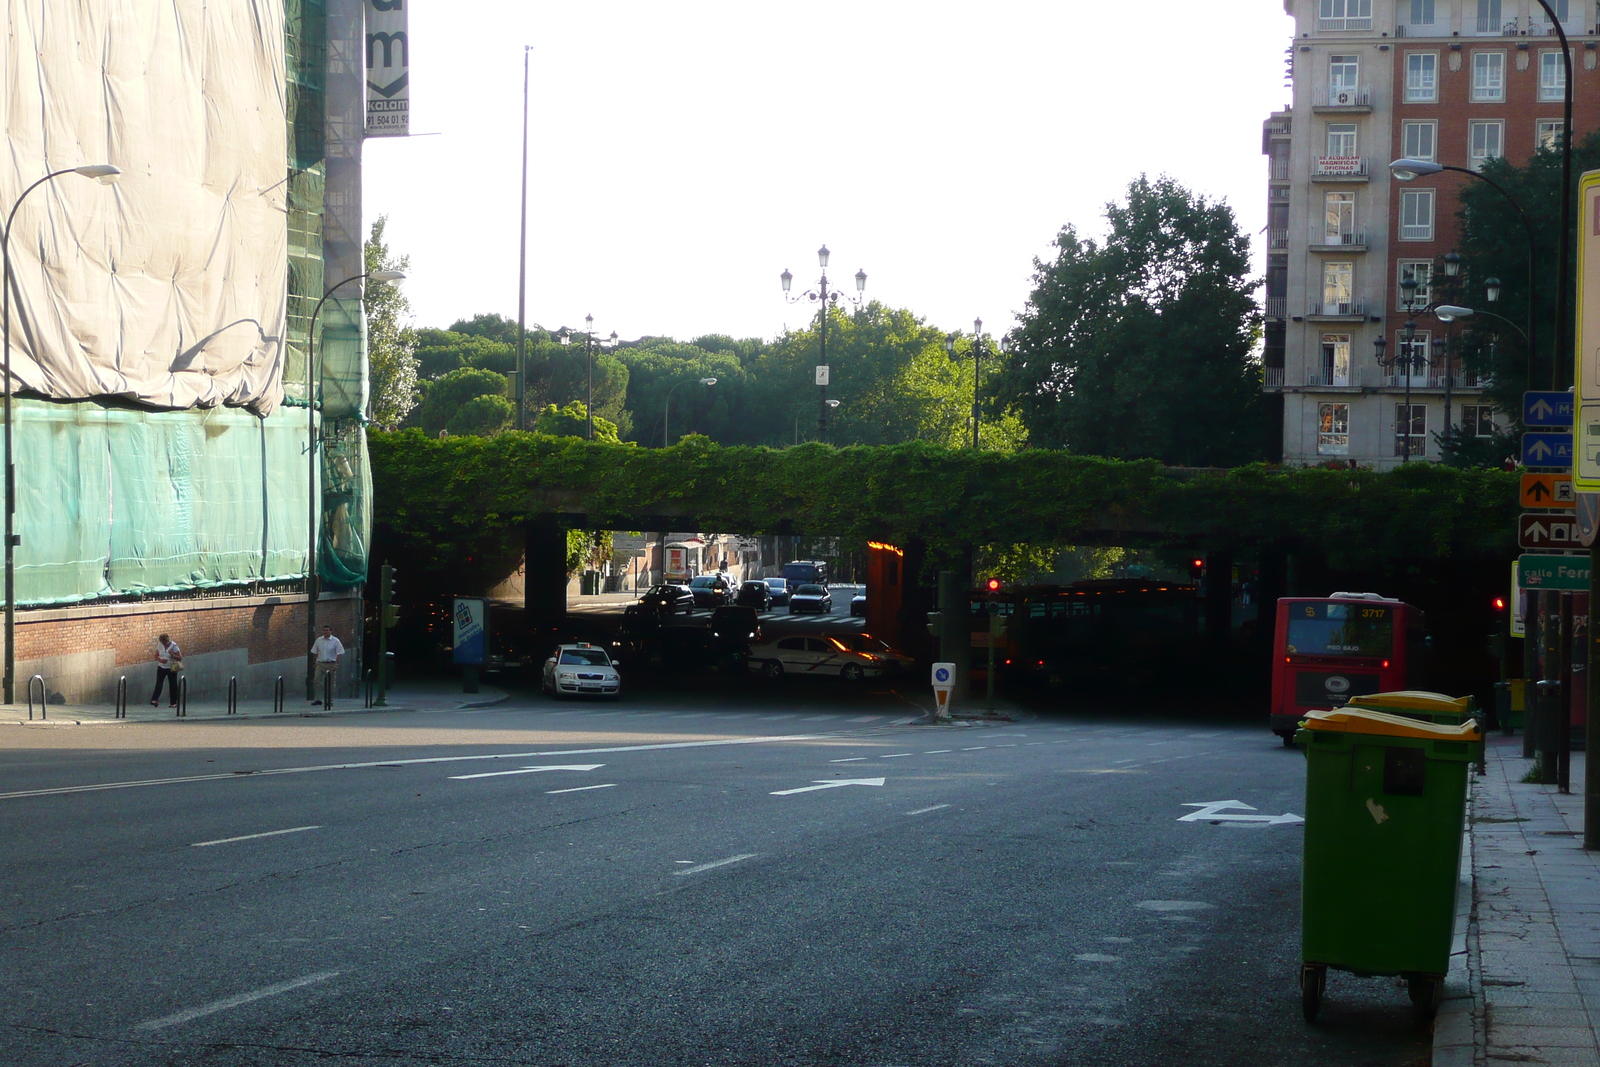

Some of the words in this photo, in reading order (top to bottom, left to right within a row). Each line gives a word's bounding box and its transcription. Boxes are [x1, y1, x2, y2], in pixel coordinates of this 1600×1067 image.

[367, 116, 374, 125] 91
[377, 115, 390, 124] 504
[391, 114, 399, 124] 01
[1525, 569, 1552, 578] calle
[1362, 609, 1385, 618] 3717
